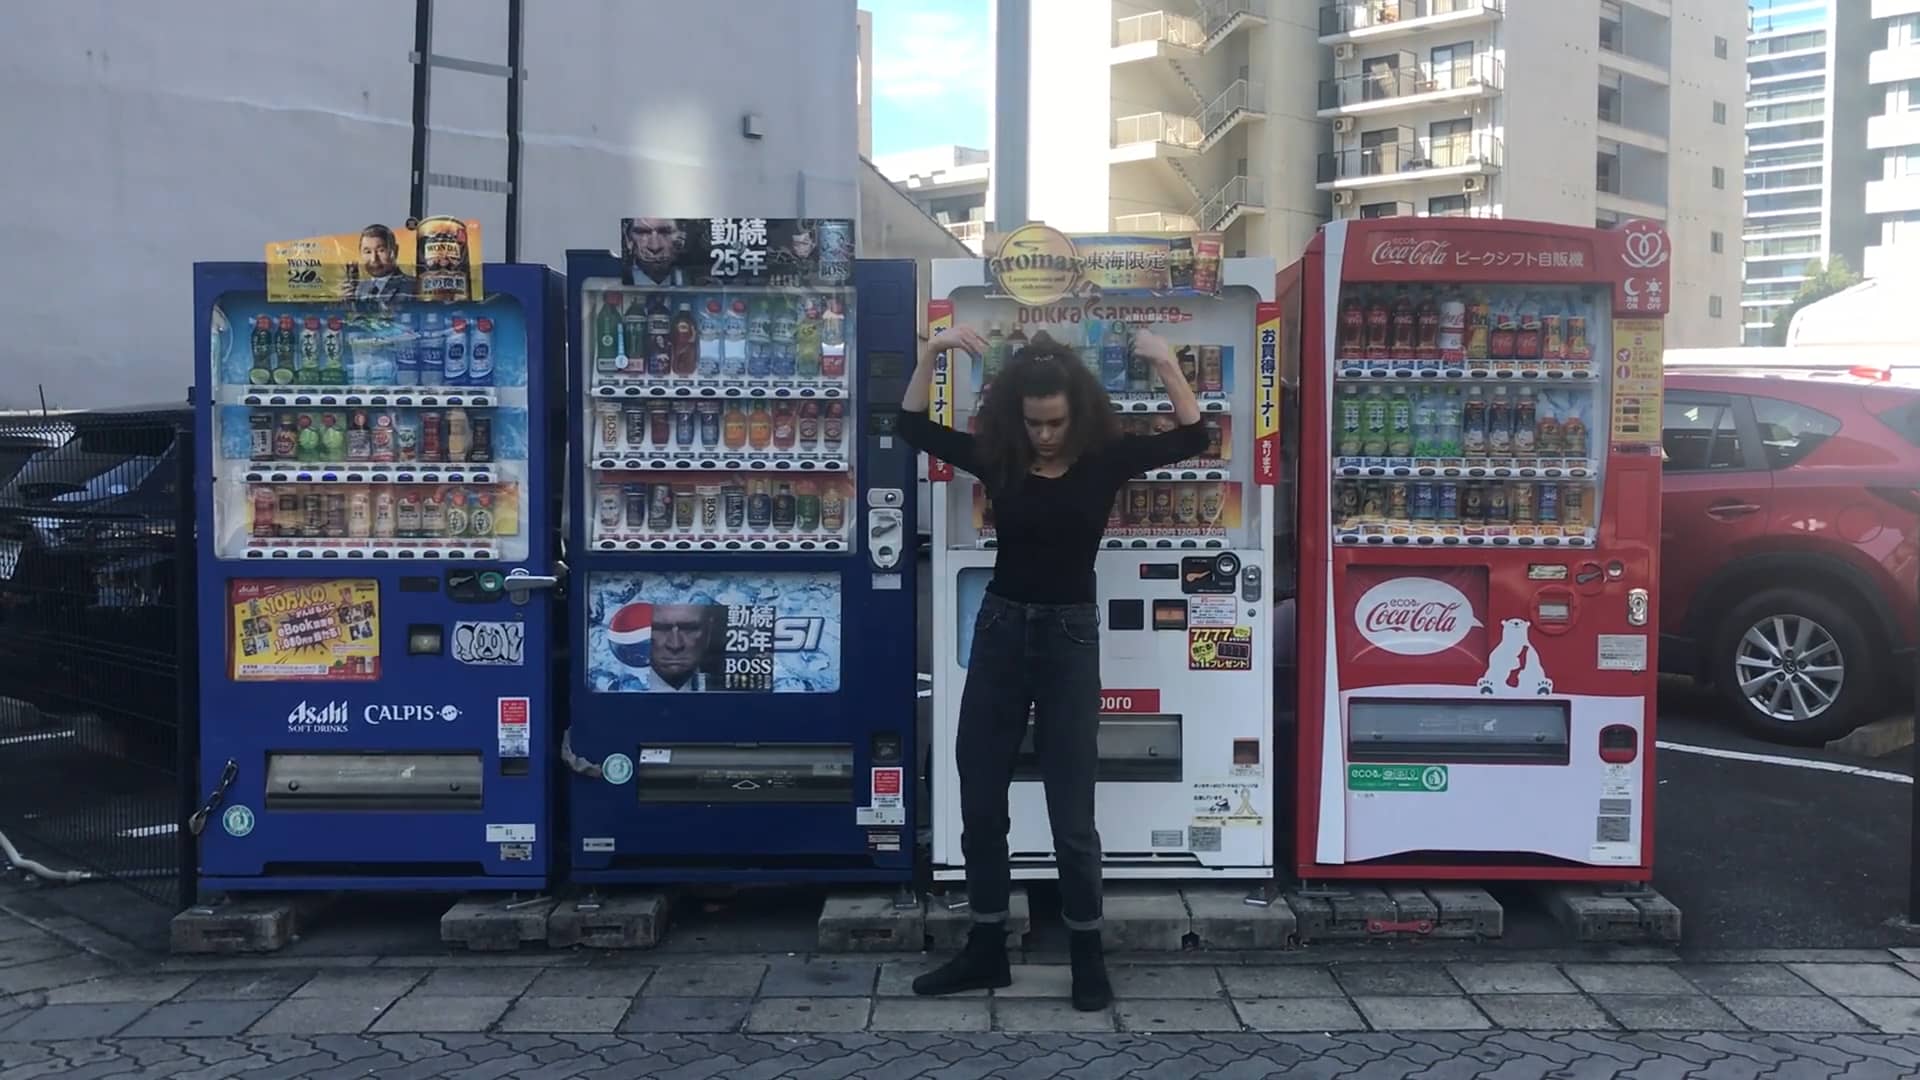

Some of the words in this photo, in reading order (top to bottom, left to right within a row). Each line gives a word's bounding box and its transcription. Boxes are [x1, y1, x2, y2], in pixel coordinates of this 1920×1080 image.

[710, 217, 768, 246] 勤続
[287, 258, 322, 267] WONDA
[710, 249, 768, 276] 25年
[1087, 251, 1166, 270] 東海限定
[1372, 240, 1451, 265] Coca-Cola
[1455, 251, 1584, 268] ピークシフト自販機
[1261, 329, 1276, 427] お買得コーナー
[727, 604, 773, 628] 勤続
[1366, 602, 1462, 632] Coca-Cola
[725, 629, 772, 652] 25年
[725, 658, 771, 674] BOSS
[288, 700, 348, 724] Asahi
[364, 704, 434, 724] CALPIS
[288, 725, 312, 733] SOFT
[314, 725, 349, 733] DRINKS
